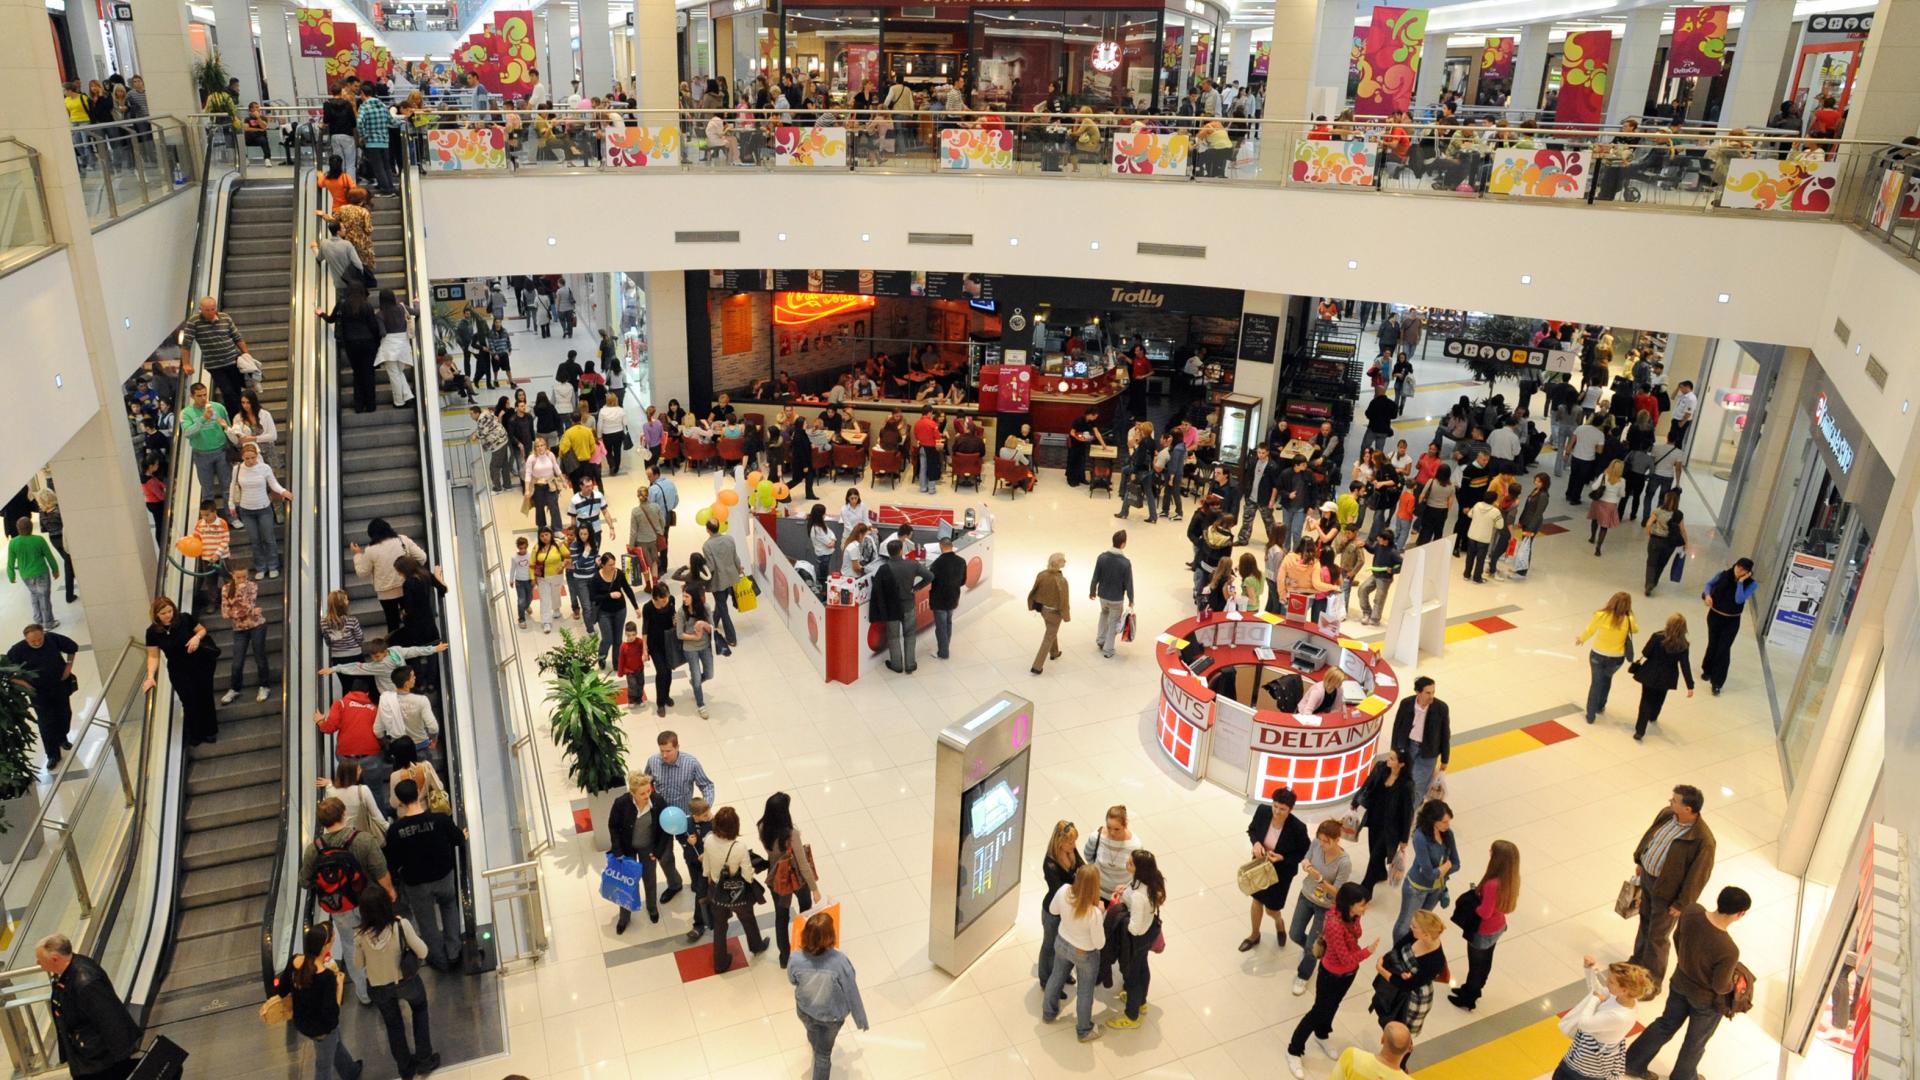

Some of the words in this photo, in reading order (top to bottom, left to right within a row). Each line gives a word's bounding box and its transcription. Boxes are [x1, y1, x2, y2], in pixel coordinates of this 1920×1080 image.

[1111, 287, 1164, 308] Trolly
[1259, 727, 1342, 748] DELTA
[399, 821, 434, 838] REPLAY
